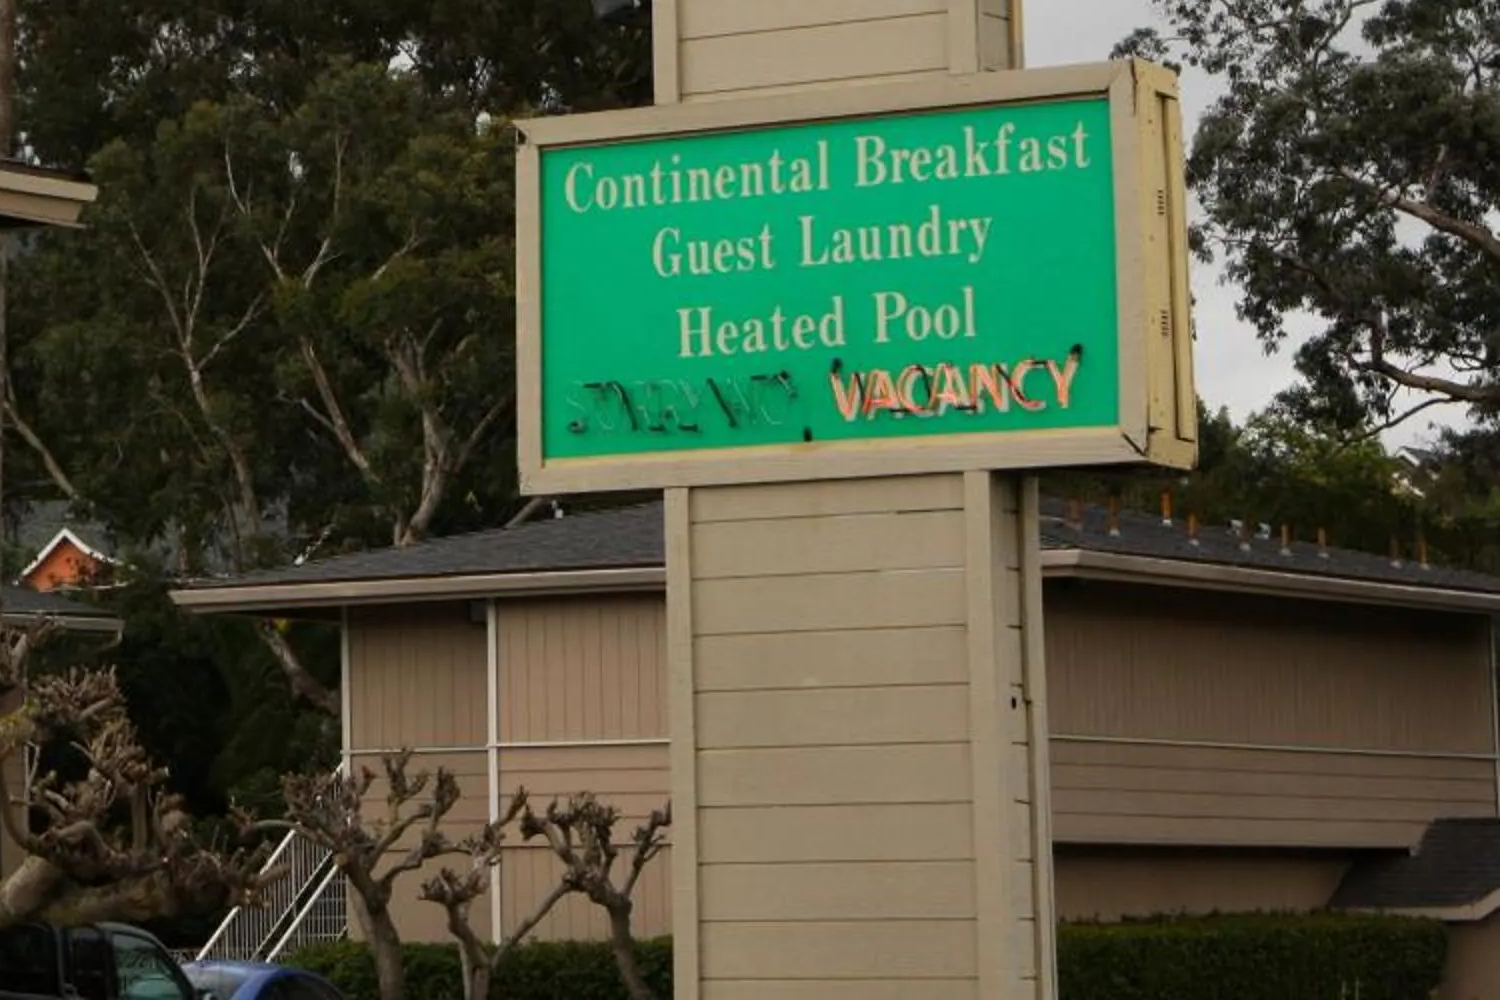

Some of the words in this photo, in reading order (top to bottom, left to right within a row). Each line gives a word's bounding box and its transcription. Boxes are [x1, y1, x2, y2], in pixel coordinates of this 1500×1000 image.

[564, 140, 830, 213] Continental
[854, 119, 1092, 188] Breakfast
[652, 222, 776, 279] Guest
[799, 204, 993, 266] Laundry
[677, 294, 846, 358] Heated
[874, 285, 977, 344] Pool
[829, 350, 1082, 421] VACANCY
